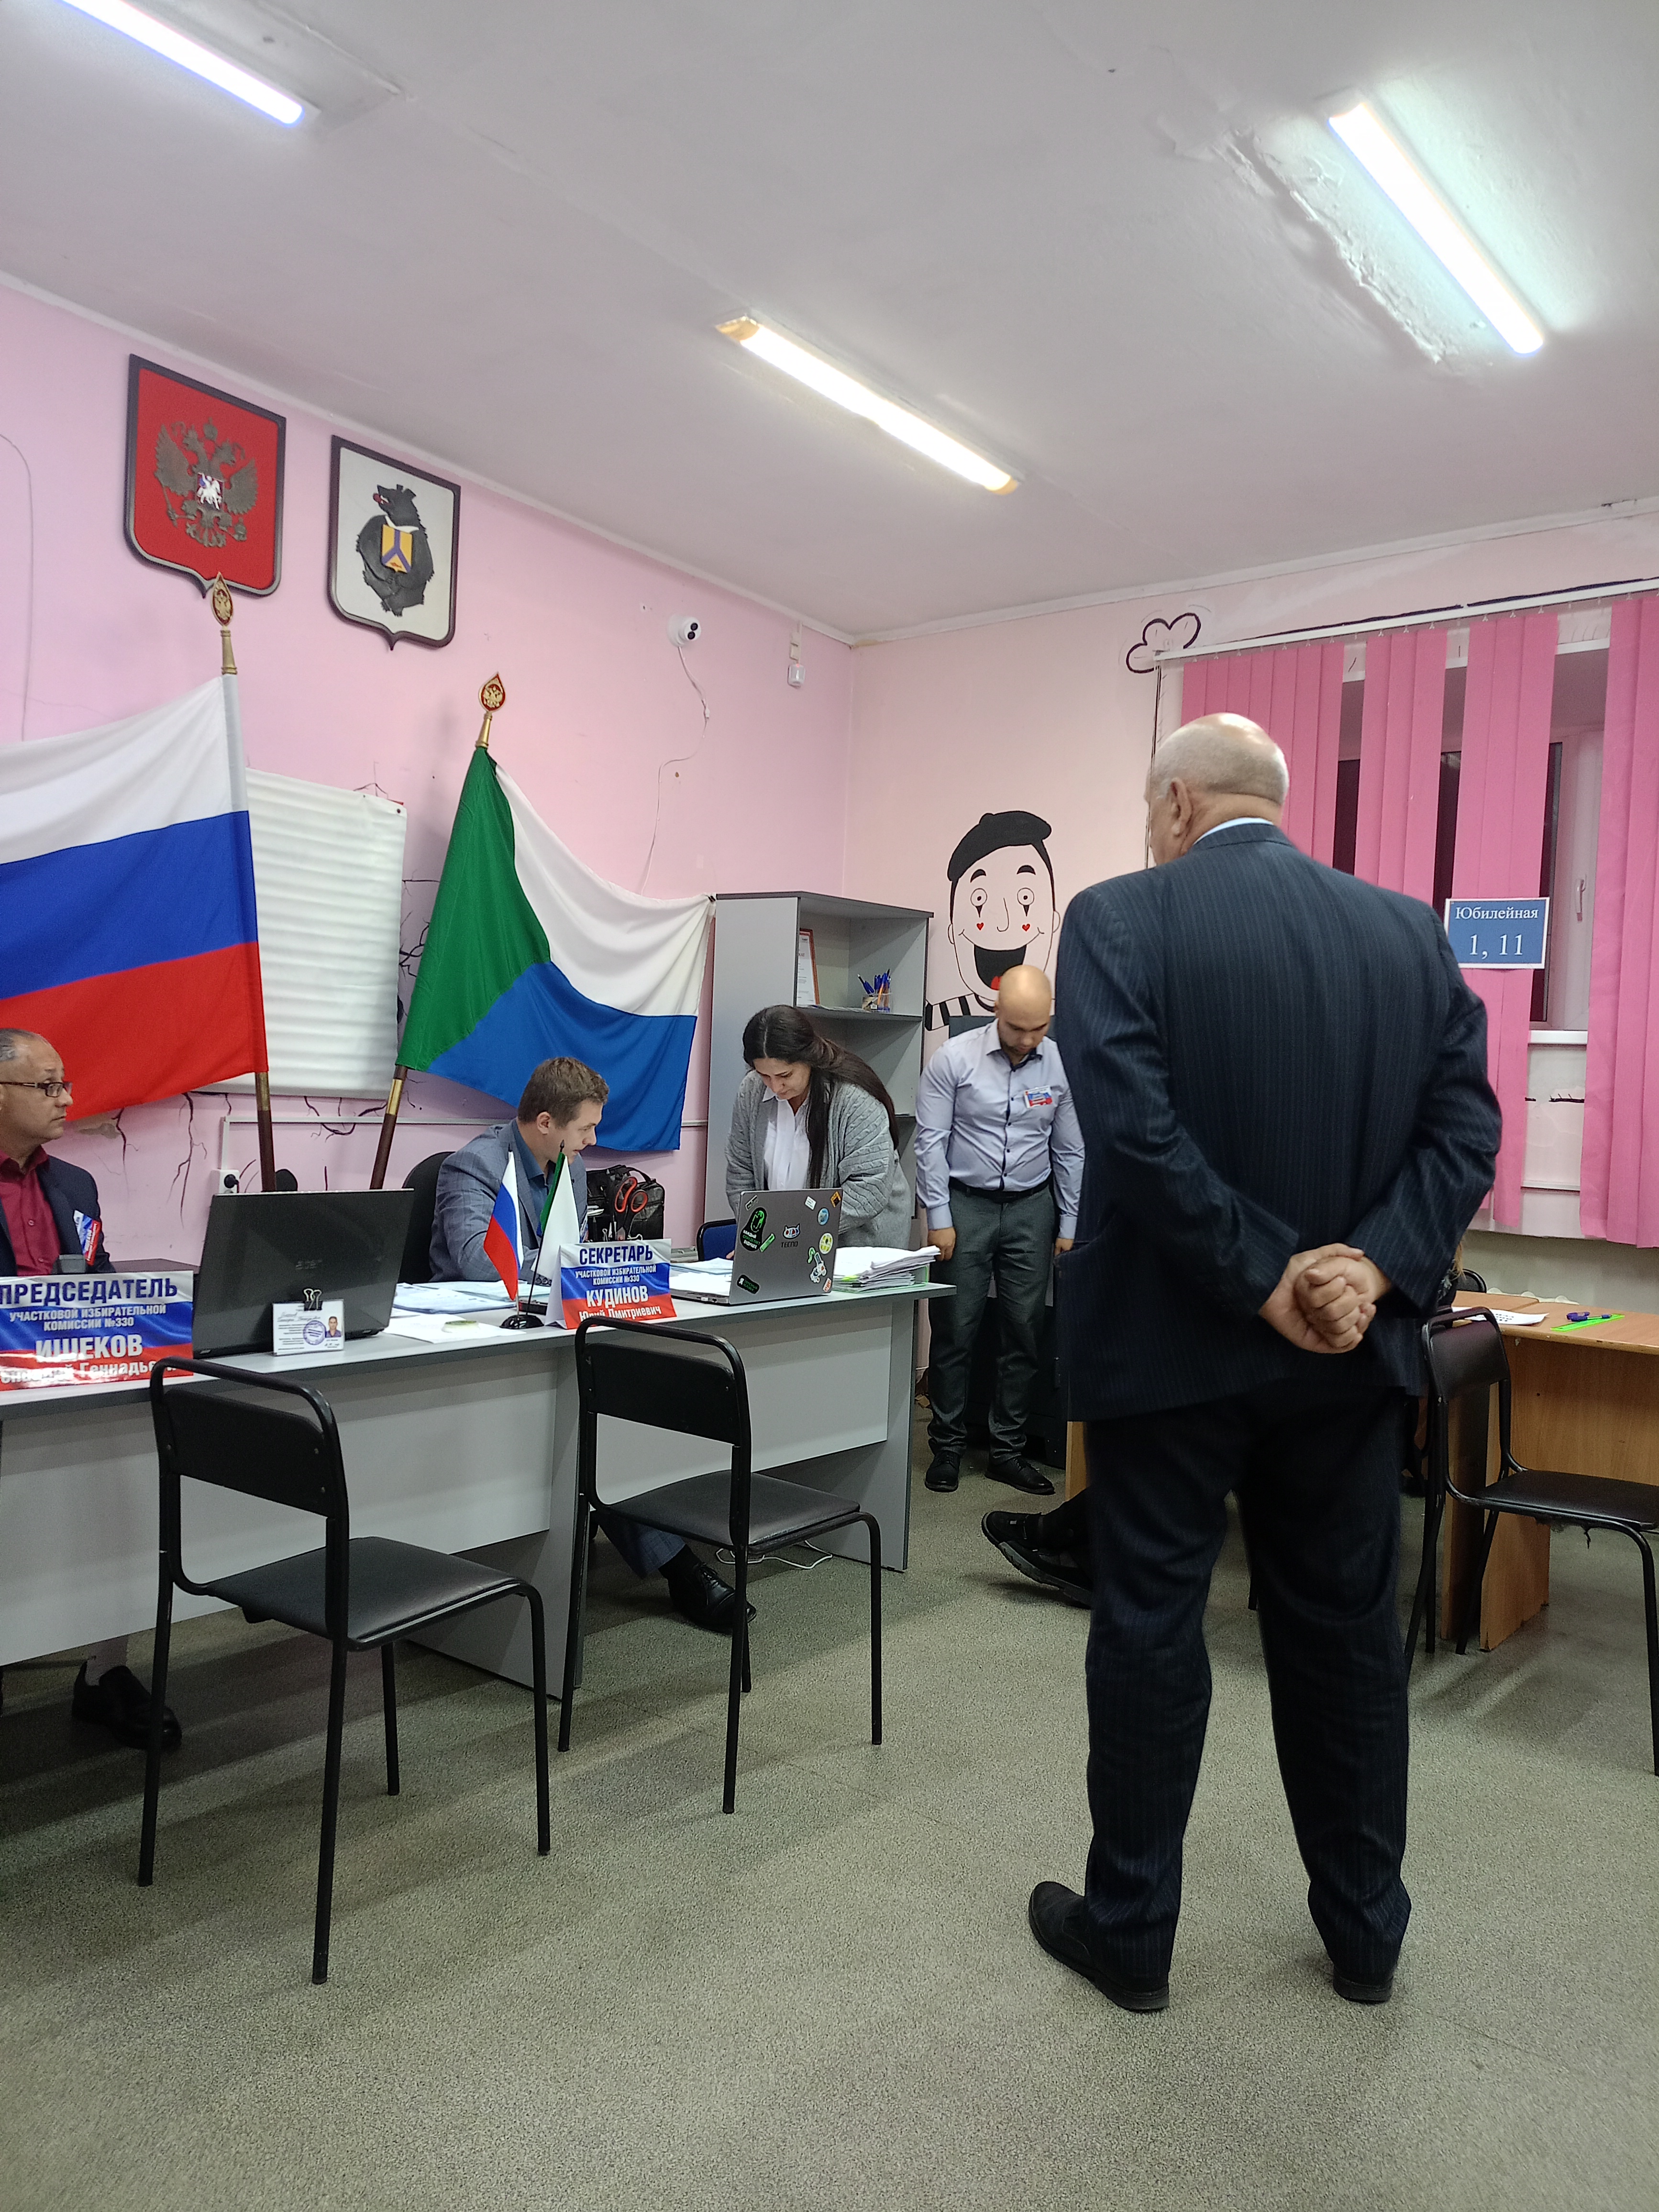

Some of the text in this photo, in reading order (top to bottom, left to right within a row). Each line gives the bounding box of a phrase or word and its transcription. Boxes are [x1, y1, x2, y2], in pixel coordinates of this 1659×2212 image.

[1455, 907, 1538, 919] Юбилейная
[1470, 934, 1523, 960] 1, 11
[579, 1245, 653, 1265] СЕКРЕТАРЬ
[575, 1264, 657, 1279] УЧАСТКОВОЙ ИЗБИРАТЕЛЬНОЙ
[593, 1275, 640, 1286] КОМИССИИ №330
[0, 1278, 177, 1306] ПРЕДСЕДАТЕЛЬ
[586, 1286, 649, 1309] КУДИНОВ
[10, 1304, 167, 1322] УЧАСТКОВОЙ ИЗБИРАТЕЛЬНОЙ
[608, 1306, 662, 1320] Дмитриевич
[44, 1316, 135, 1332] КОМИССИИ №330
